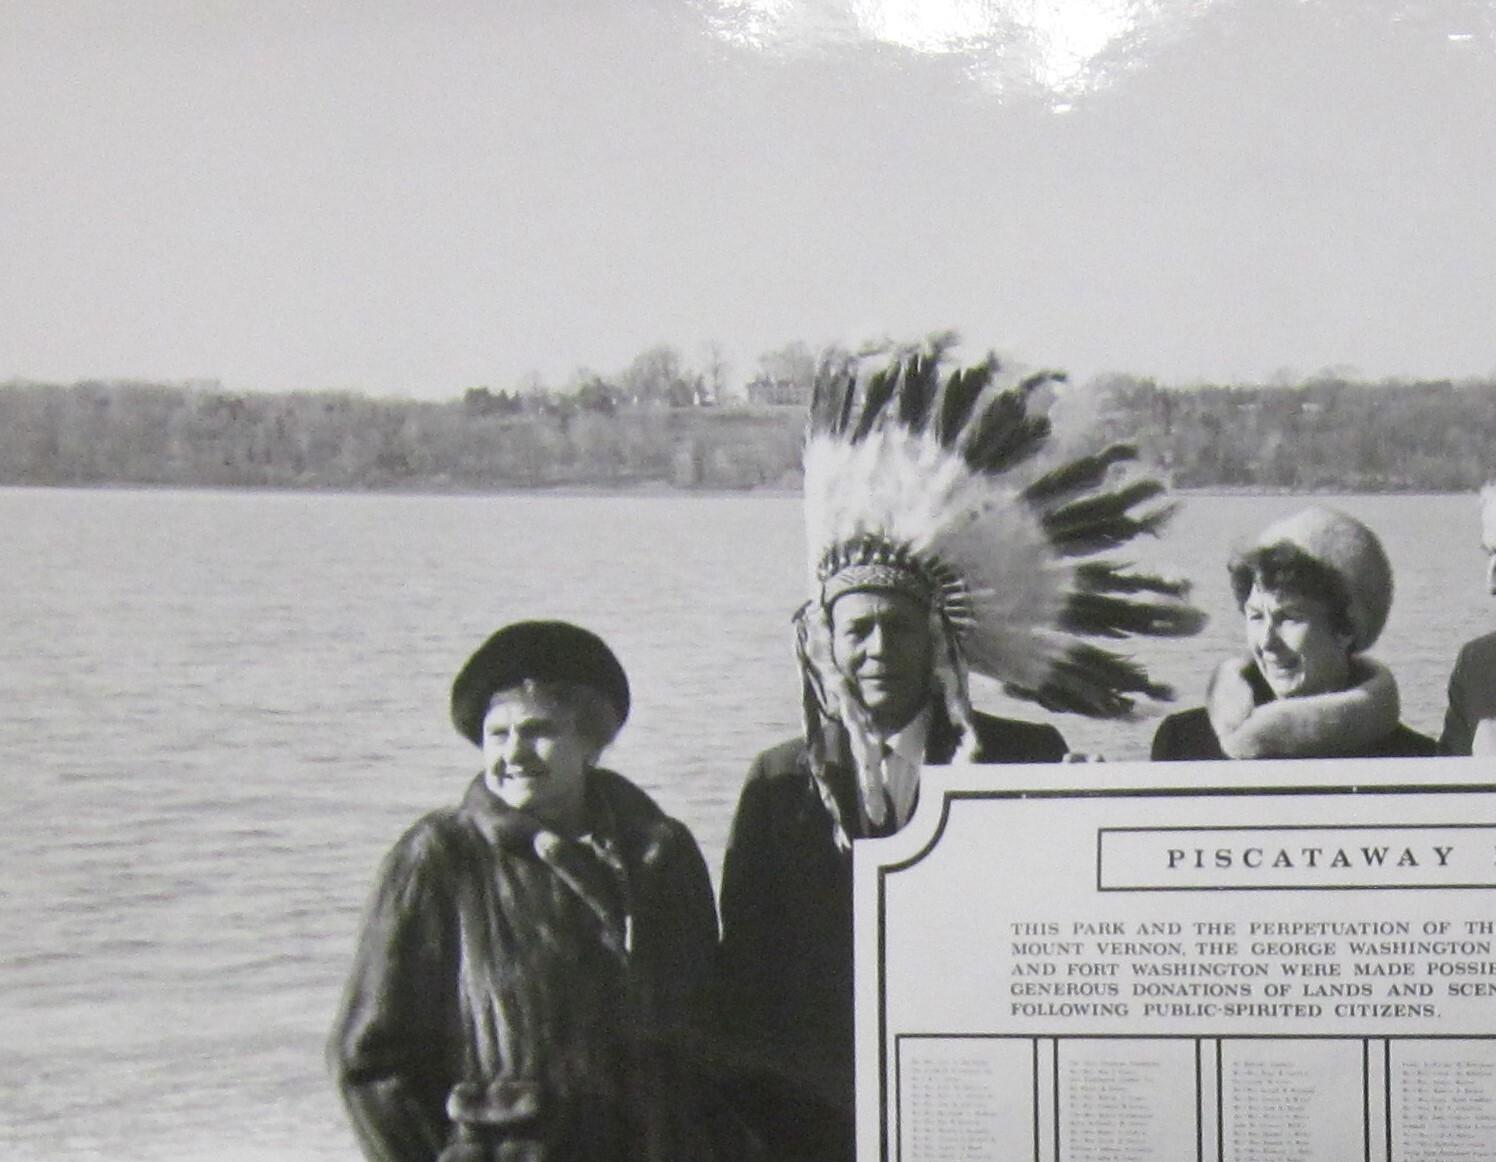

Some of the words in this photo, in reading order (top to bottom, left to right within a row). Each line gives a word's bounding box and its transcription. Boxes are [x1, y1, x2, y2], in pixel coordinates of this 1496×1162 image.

[1166, 846, 1454, 870] PISCATAWAY
[1010, 922, 1060, 936] THIS
[1073, 921, 1126, 936] PARK
[1136, 922, 1182, 936] AND
[1192, 922, 1236, 936] THE
[1249, 921, 1410, 936] PERPETUATION
[1422, 920, 1452, 936] OF
[1011, 942, 1085, 956] MOUNT
[1194, 942, 1238, 956] THE
[1250, 942, 1336, 956] GEORGE
[1348, 941, 1491, 956] WASHINGTON
[1011, 963, 1057, 976] AND
[1067, 963, 1120, 977] FORT
[1131, 962, 1269, 977] WASHINGTON
[1280, 963, 1341, 977] WERE
[1353, 962, 1415, 977] MADE
[1010, 982, 1119, 997] GENEROUS
[1132, 982, 1252, 997] DONATIONS
[1263, 983, 1292, 998] OF
[1302, 983, 1373, 998] LANDS
[1387, 983, 1434, 997] AND
[1010, 1002, 1129, 1017] FOLLOWING
[1143, 1003, 1323, 1018] PUBLIC-SPIRITED
[1334, 1003, 1441, 1018] CITIZENS.
